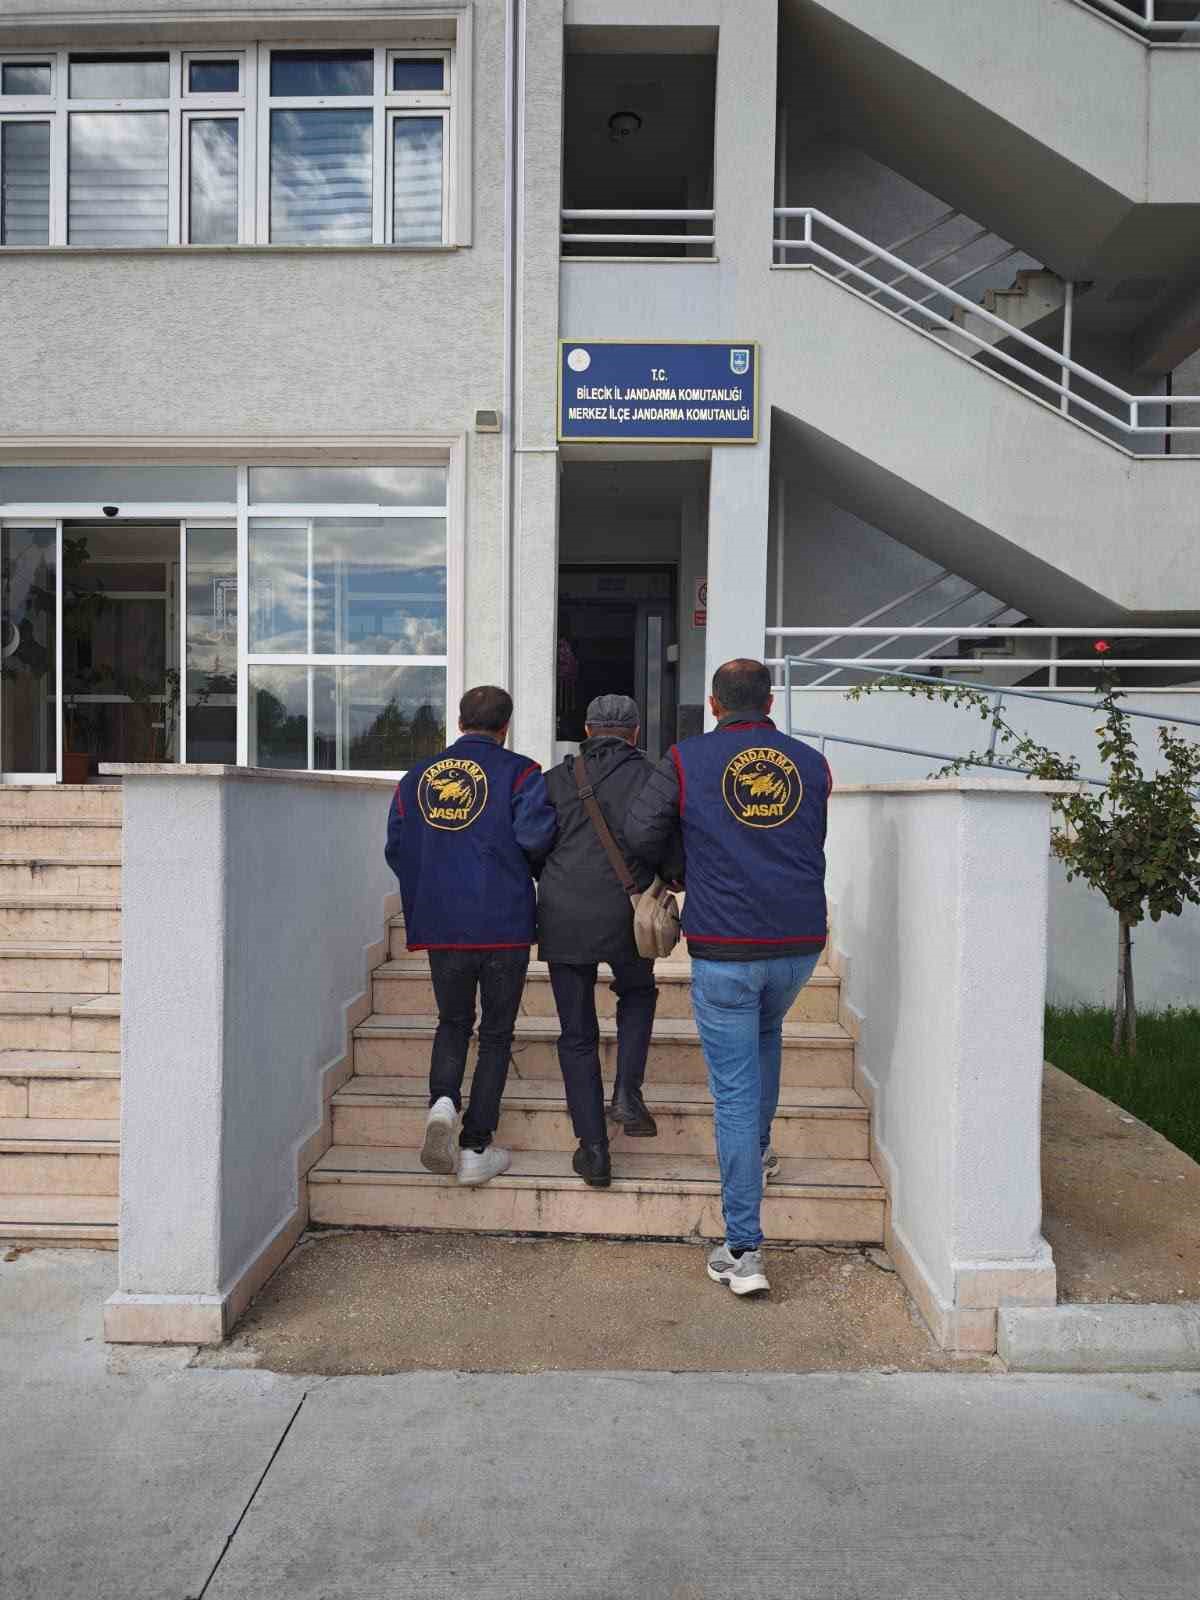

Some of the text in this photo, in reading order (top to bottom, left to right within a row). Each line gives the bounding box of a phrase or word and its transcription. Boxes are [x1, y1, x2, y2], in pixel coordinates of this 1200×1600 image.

[651, 369, 668, 381] T.C.
[577, 385, 742, 401] BİLECİK İL JANDARMA KOMUTANLIĞI
[568, 405, 750, 423] MERKEZ İLÇE JANDARMA KOMUTANLIĞI
[424, 760, 484, 782] JANDARMA
[729, 750, 794, 776] JANDARMA
[430, 807, 470, 820] JASAT
[742, 803, 785, 817] JASAT
